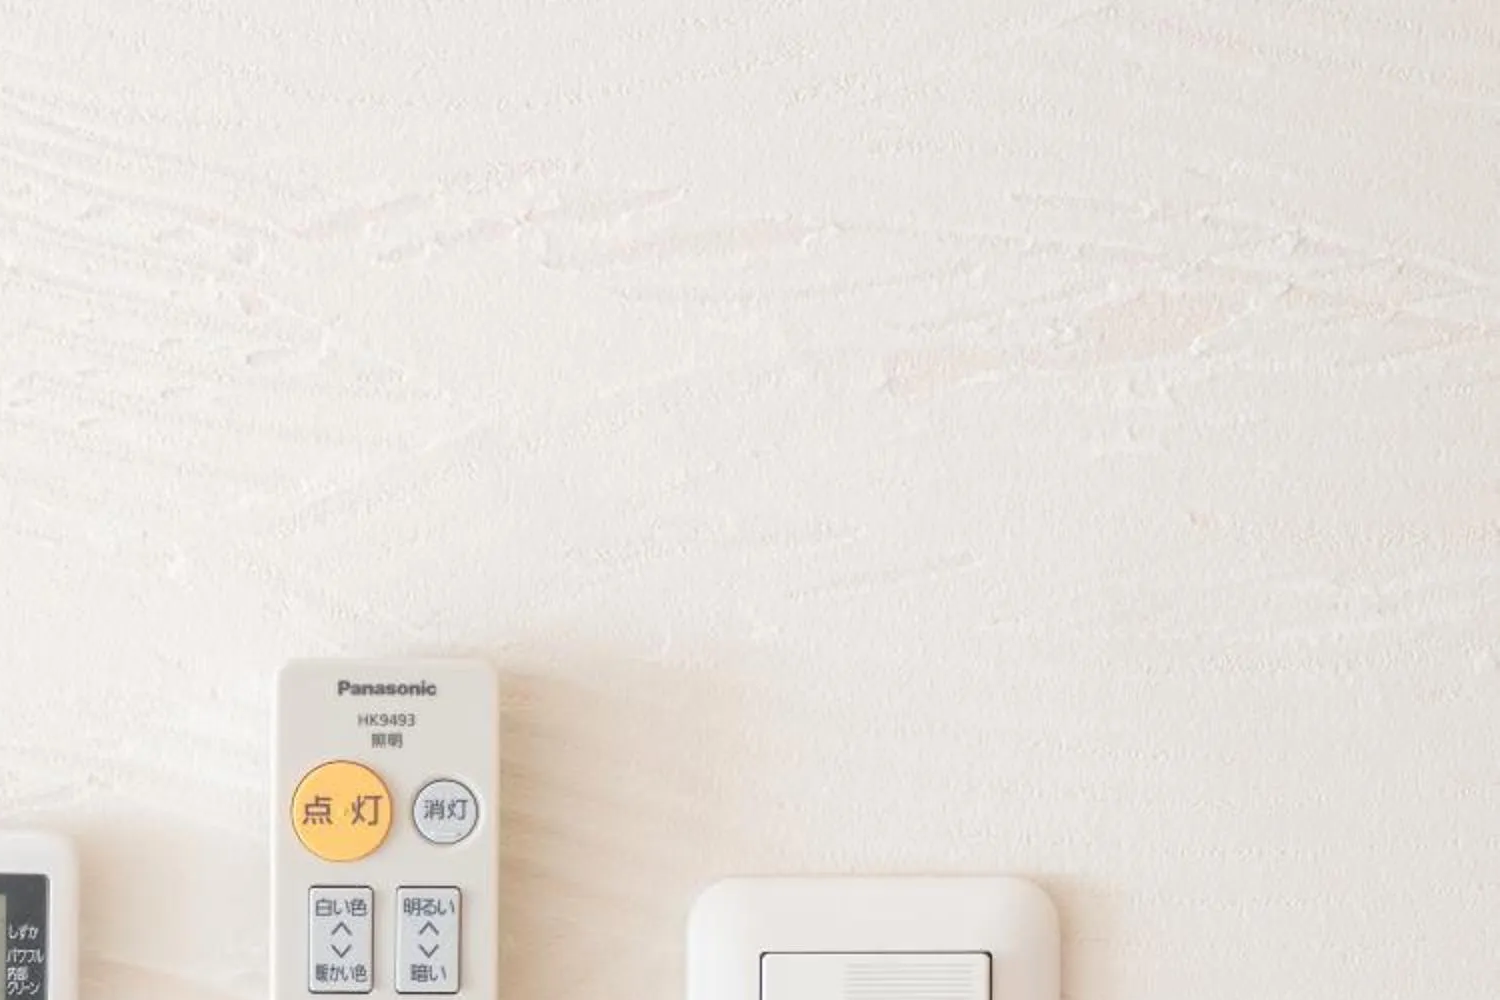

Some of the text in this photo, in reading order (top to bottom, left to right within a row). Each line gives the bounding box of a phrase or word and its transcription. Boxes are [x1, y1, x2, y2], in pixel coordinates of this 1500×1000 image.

[337, 680, 437, 696] Panasonic
[357, 713, 416, 727] HK9493
[371, 733, 403, 749] 照明
[423, 799, 468, 820] 消灯
[316, 898, 368, 917] 白い色
[403, 897, 455, 917] 明るい
[8, 924, 39, 940] しずか
[6, 948, 44, 963] パワフル
[316, 963, 367, 983] 暖かい色
[410, 963, 447, 983] 暗い
